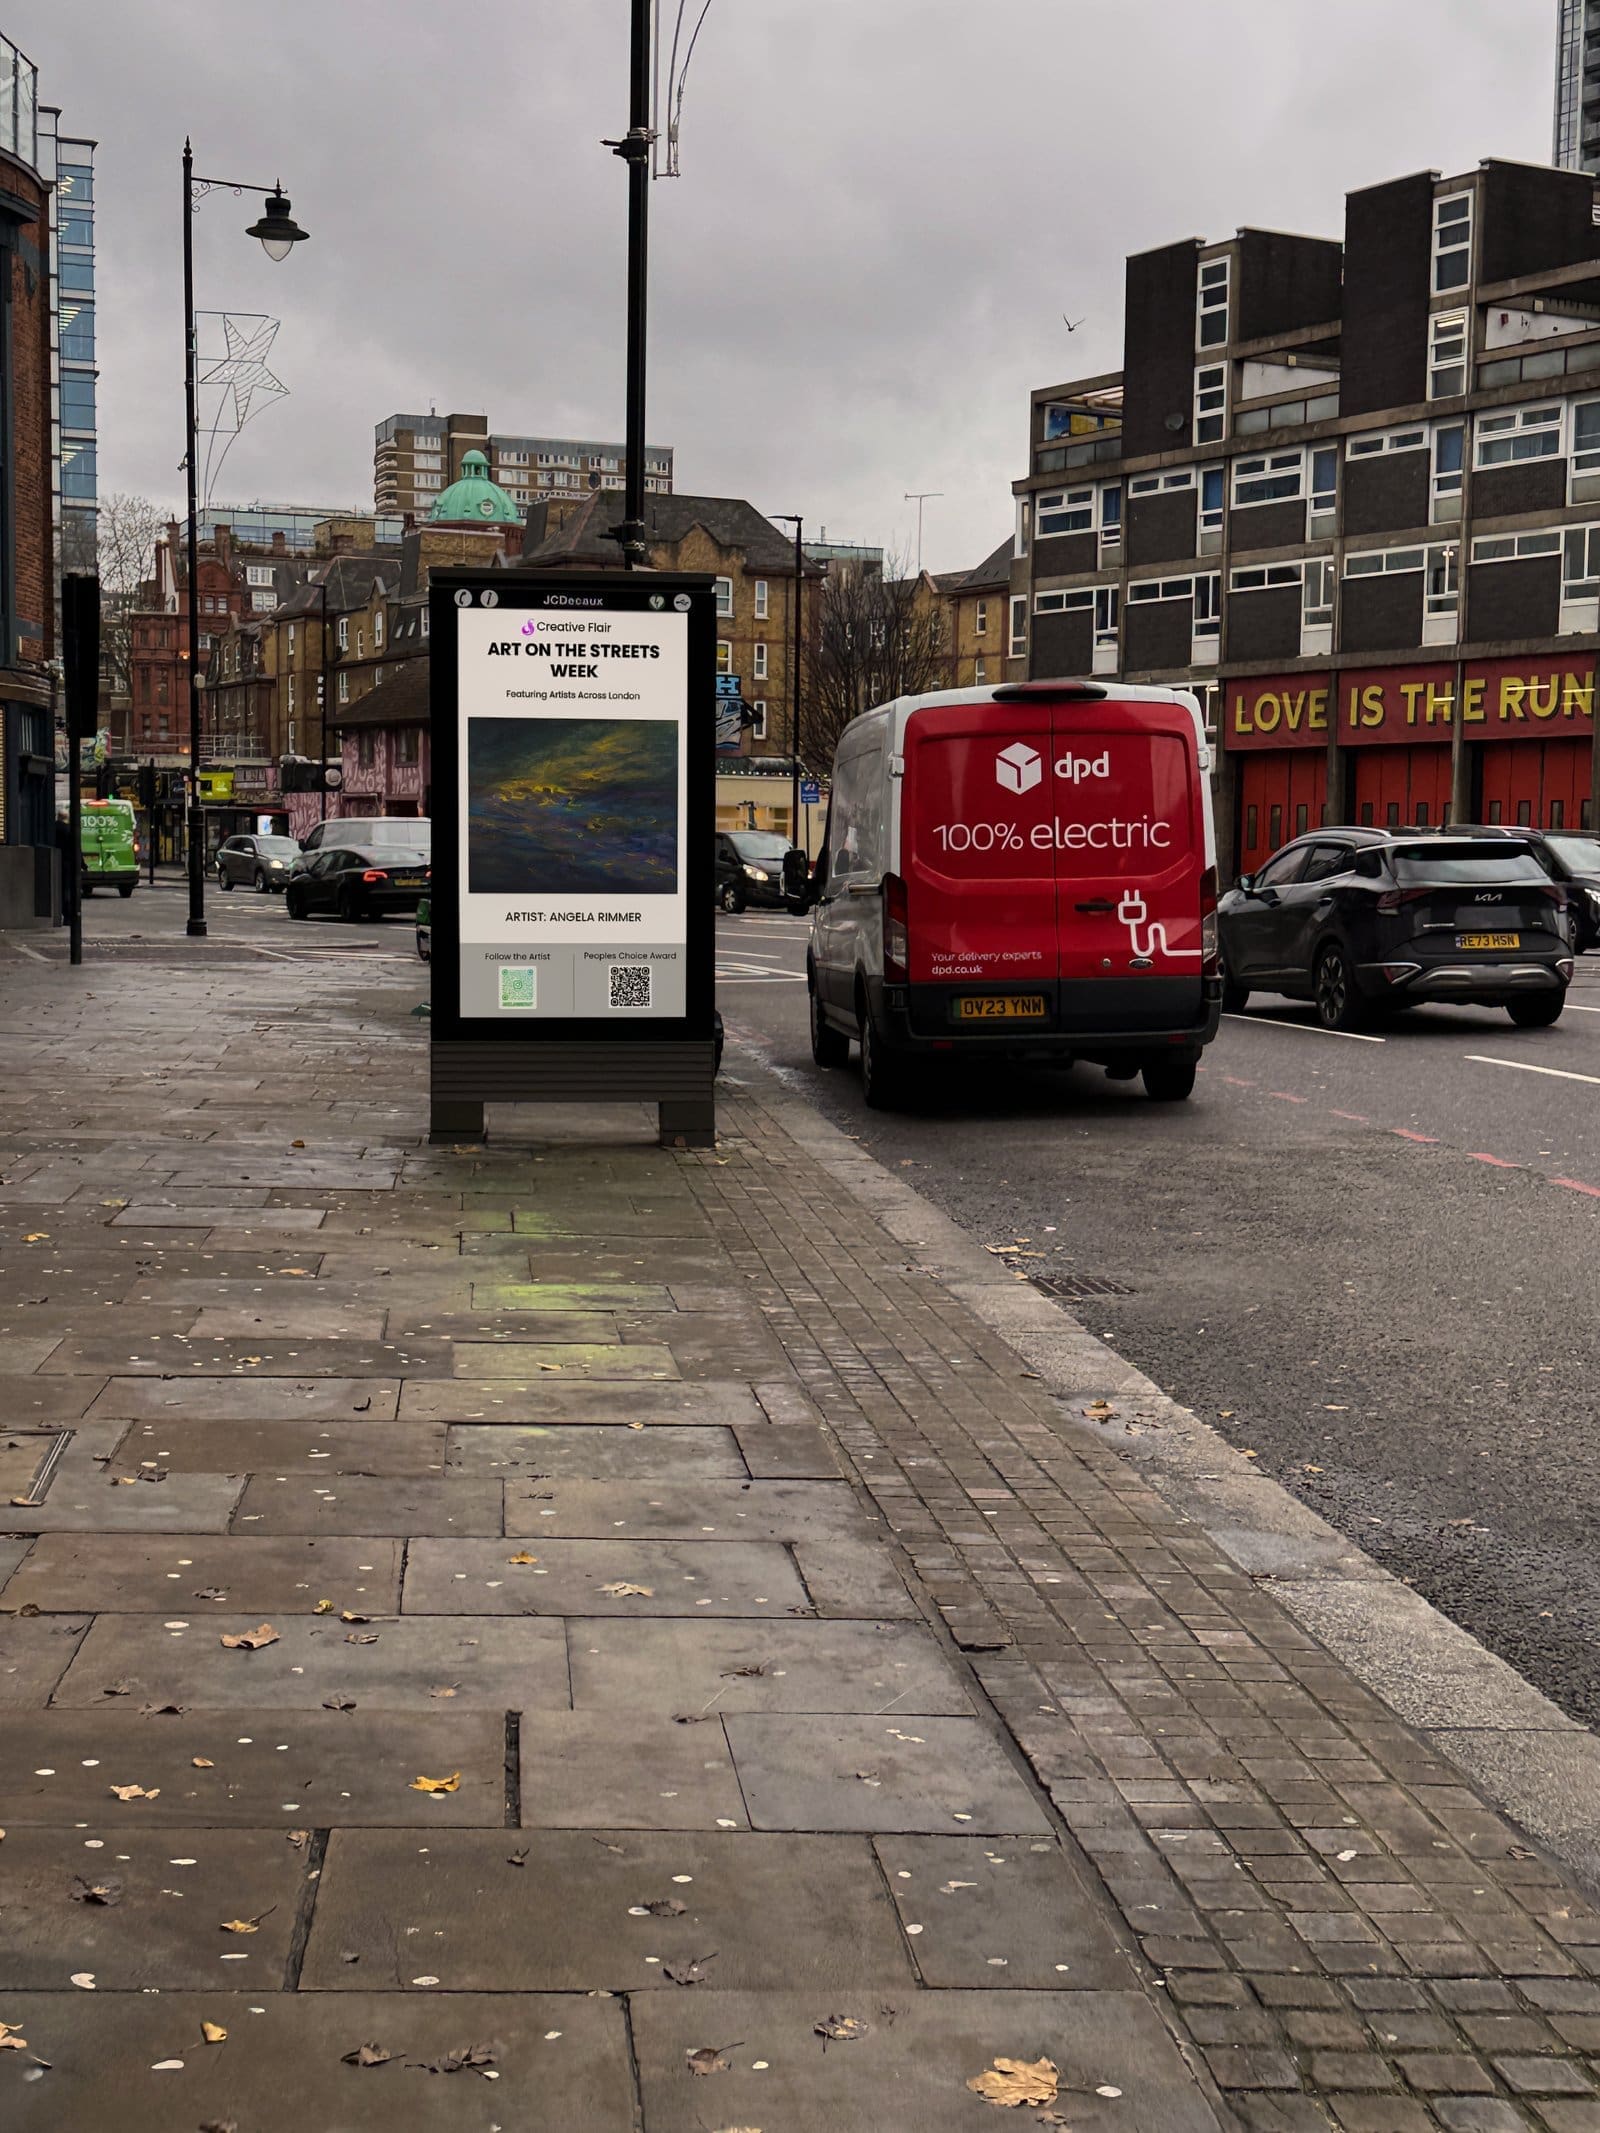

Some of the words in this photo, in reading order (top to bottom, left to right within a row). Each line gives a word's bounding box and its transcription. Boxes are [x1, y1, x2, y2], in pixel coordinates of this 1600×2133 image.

[543, 595, 603, 606] JCDecaux
[536, 621, 586, 632] Creative
[588, 622, 612, 633] Flair
[487, 642, 521, 656] ART
[525, 643, 551, 656] ON
[555, 643, 587, 657] THE
[590, 644, 660, 659] STREETS
[550, 664, 599, 678] WEEK
[506, 689, 548, 701] Featuring
[549, 690, 576, 700] Artists
[578, 691, 607, 700] Across
[608, 692, 641, 701] London
[1234, 689, 1329, 733] LOVE
[1350, 685, 1385, 728] IS
[1400, 679, 1487, 725] THE
[1054, 751, 1109, 784] dpd
[932, 822, 1024, 851] 100%
[1030, 814, 1171, 850] electric
[505, 911, 547, 922] ARTIST:
[549, 912, 595, 922] ANGELA
[597, 912, 642, 922] RIMMER
[484, 952, 510, 961] Follow
[513, 952, 527, 961] the
[529, 952, 551, 961] Artist
[583, 951, 616, 962] Peoples
[618, 951, 648, 961] Choice
[650, 951, 677, 961] Award
[931, 952, 955, 962] Your
[958, 952, 1001, 963] delivery
[1002, 951, 1042, 962] experts
[931, 964, 983, 976] dpd.co.uk
[1010, 997, 1042, 1014] YNW
